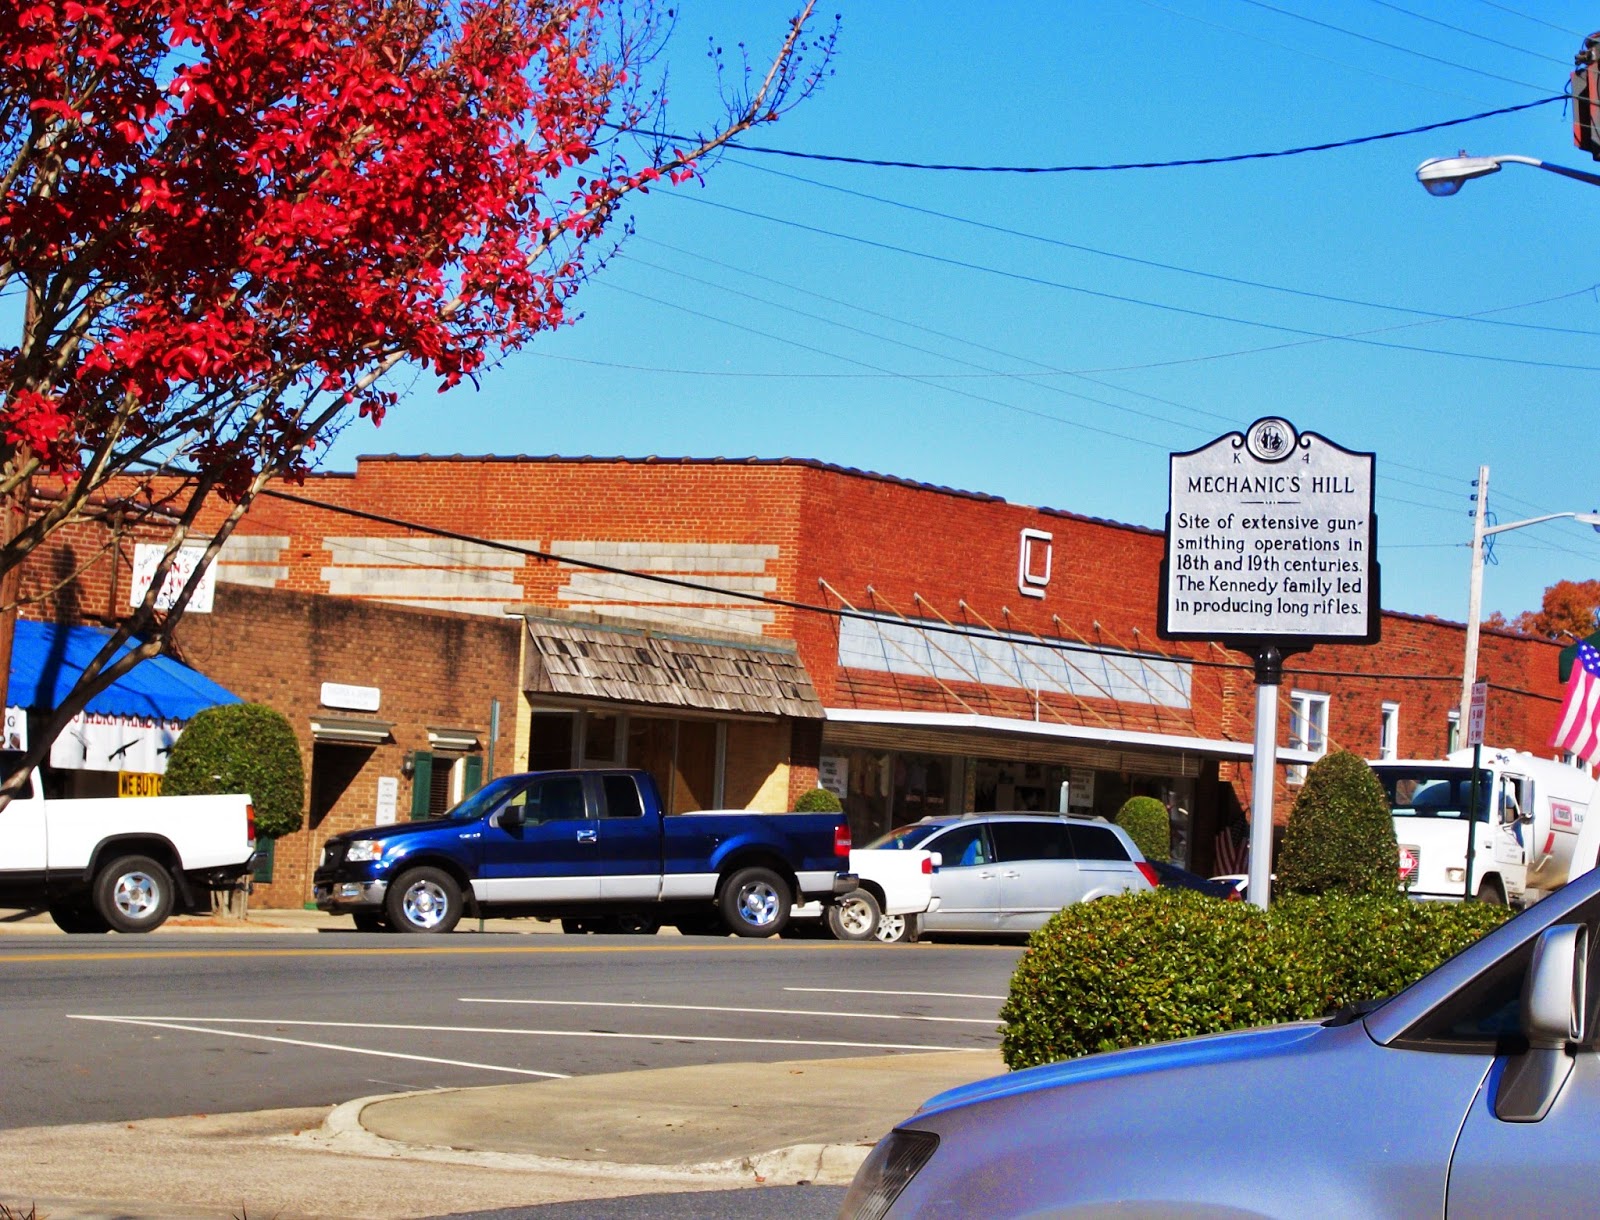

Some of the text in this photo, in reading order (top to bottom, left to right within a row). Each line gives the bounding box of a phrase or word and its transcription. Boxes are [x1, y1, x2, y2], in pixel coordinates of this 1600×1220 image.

[1233, 452, 1310, 464] K 4
[1188, 476, 1355, 493] MECHANIC'S HILL
[1178, 512, 1210, 529] Site
[1217, 513, 1235, 529] of
[1242, 514, 1319, 530] extensive
[1177, 534, 1363, 553] smithing operations in
[1177, 554, 1362, 572] 18th and 19th centuries.
[1176, 574, 1362, 597] The Kennedy family led
[1175, 596, 1361, 617] in producing long rifles.
[121, 775, 133, 796] WE
[136, 775, 155, 796] BUY
